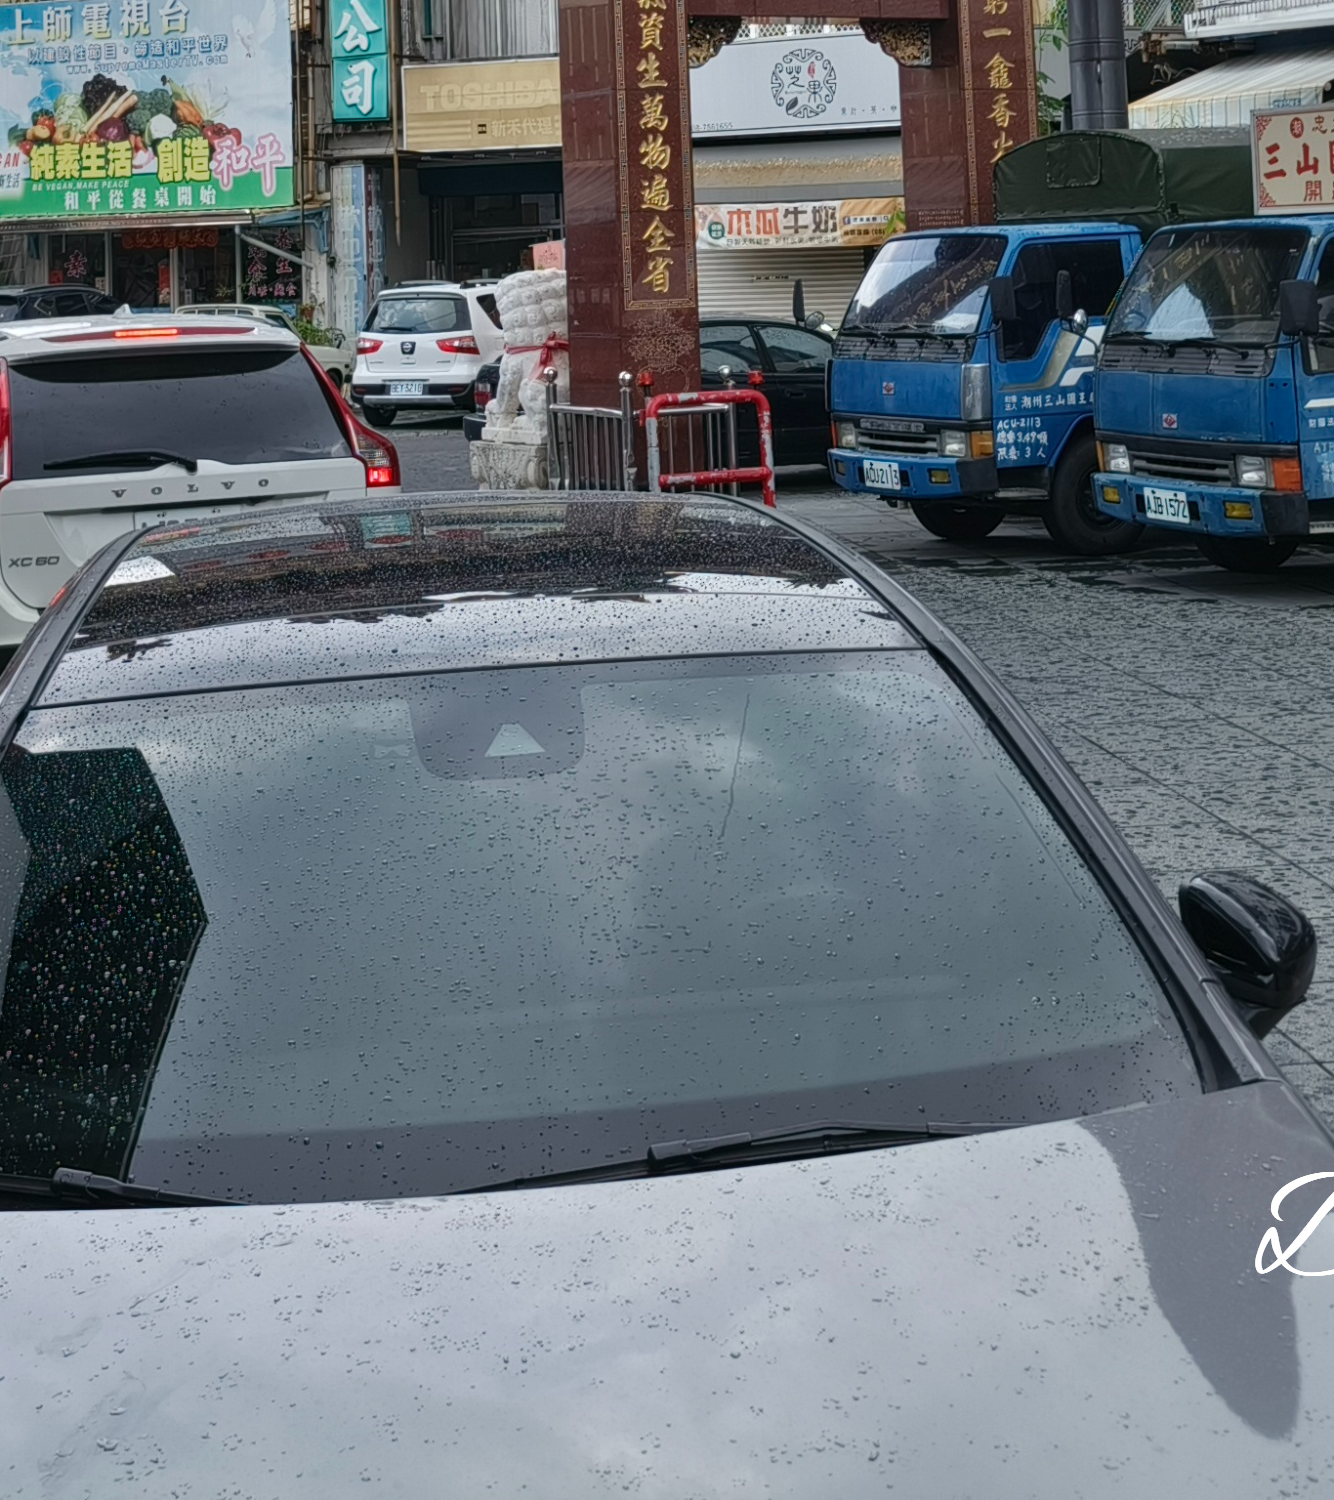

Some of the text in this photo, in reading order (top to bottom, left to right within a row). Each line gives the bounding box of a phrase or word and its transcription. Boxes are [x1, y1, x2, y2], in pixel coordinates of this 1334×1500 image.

[29, 132, 286, 197] 純素生活 創造 和平
[63, 185, 217, 211] 和平從餐桌開始
[726, 205, 838, 237] 木瓜牛奶
[1021, 392, 1094, 409] 潮州三山國王
[111, 479, 269, 498] VOLVO
